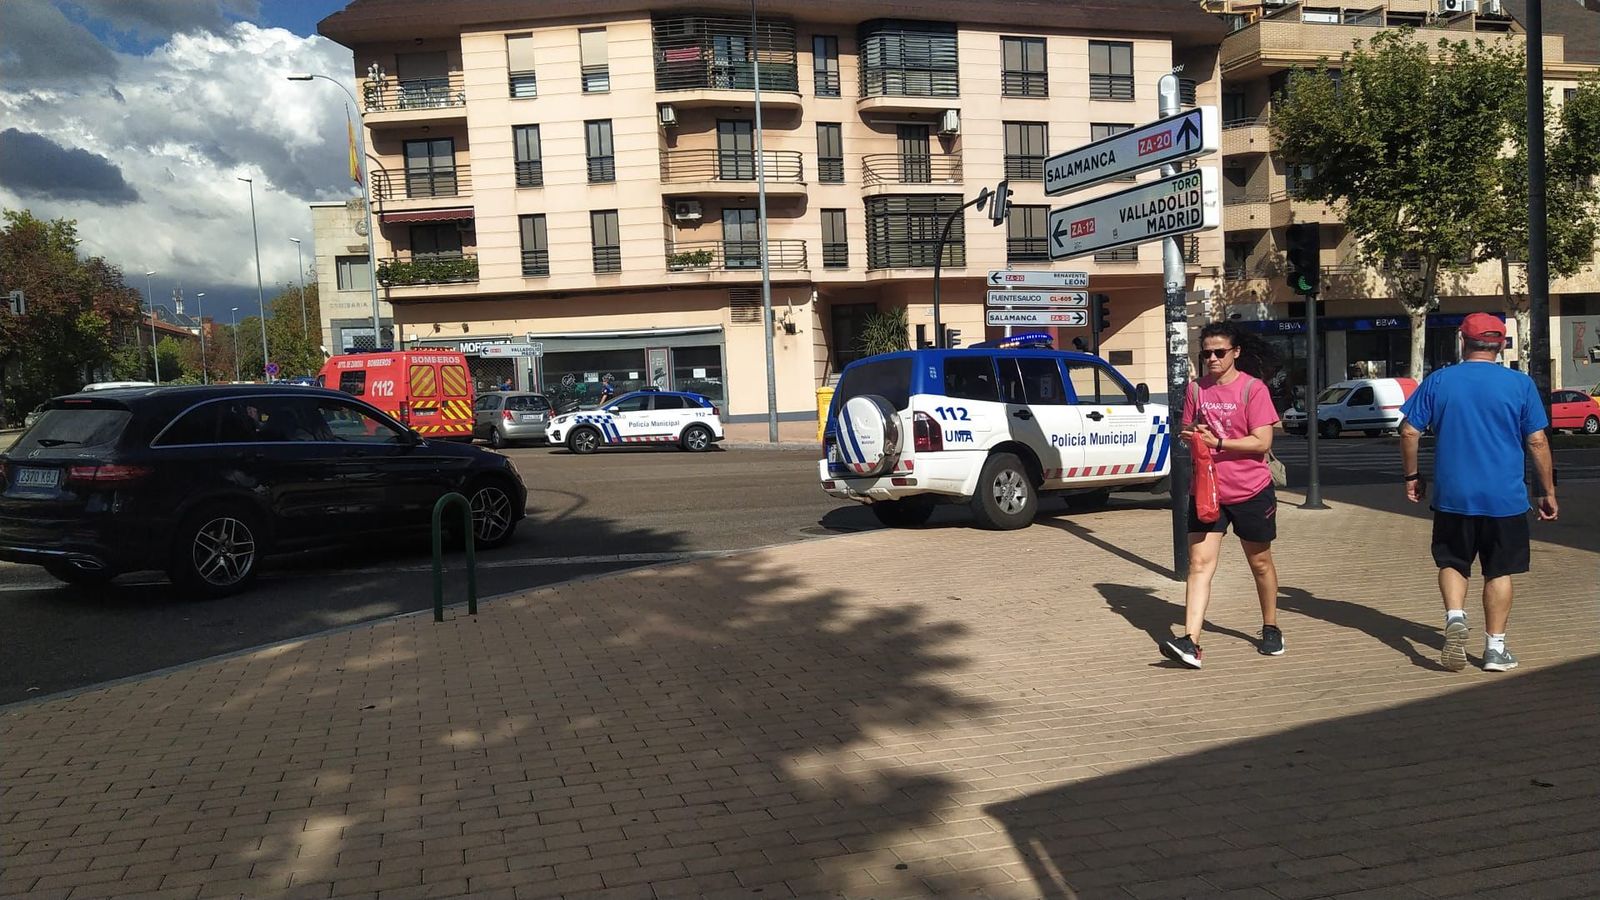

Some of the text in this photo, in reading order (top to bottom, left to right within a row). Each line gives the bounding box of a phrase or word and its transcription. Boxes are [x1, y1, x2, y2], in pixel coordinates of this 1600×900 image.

[1046, 133, 1171, 183] SALAMANCA ZA-20
[1172, 175, 1199, 193] TORO
[1119, 190, 1199, 223] VALLADOLID
[1071, 220, 1095, 237] ZA-12
[1147, 208, 1200, 234] MADRID
[1279, 322, 1301, 330] BBVA
[411, 356, 460, 364] BOMBEROS
[376, 380, 394, 396] 112
[935, 406, 971, 421] 112
[945, 430, 974, 442] UMA
[1051, 431, 1137, 447] Policía Municipal
